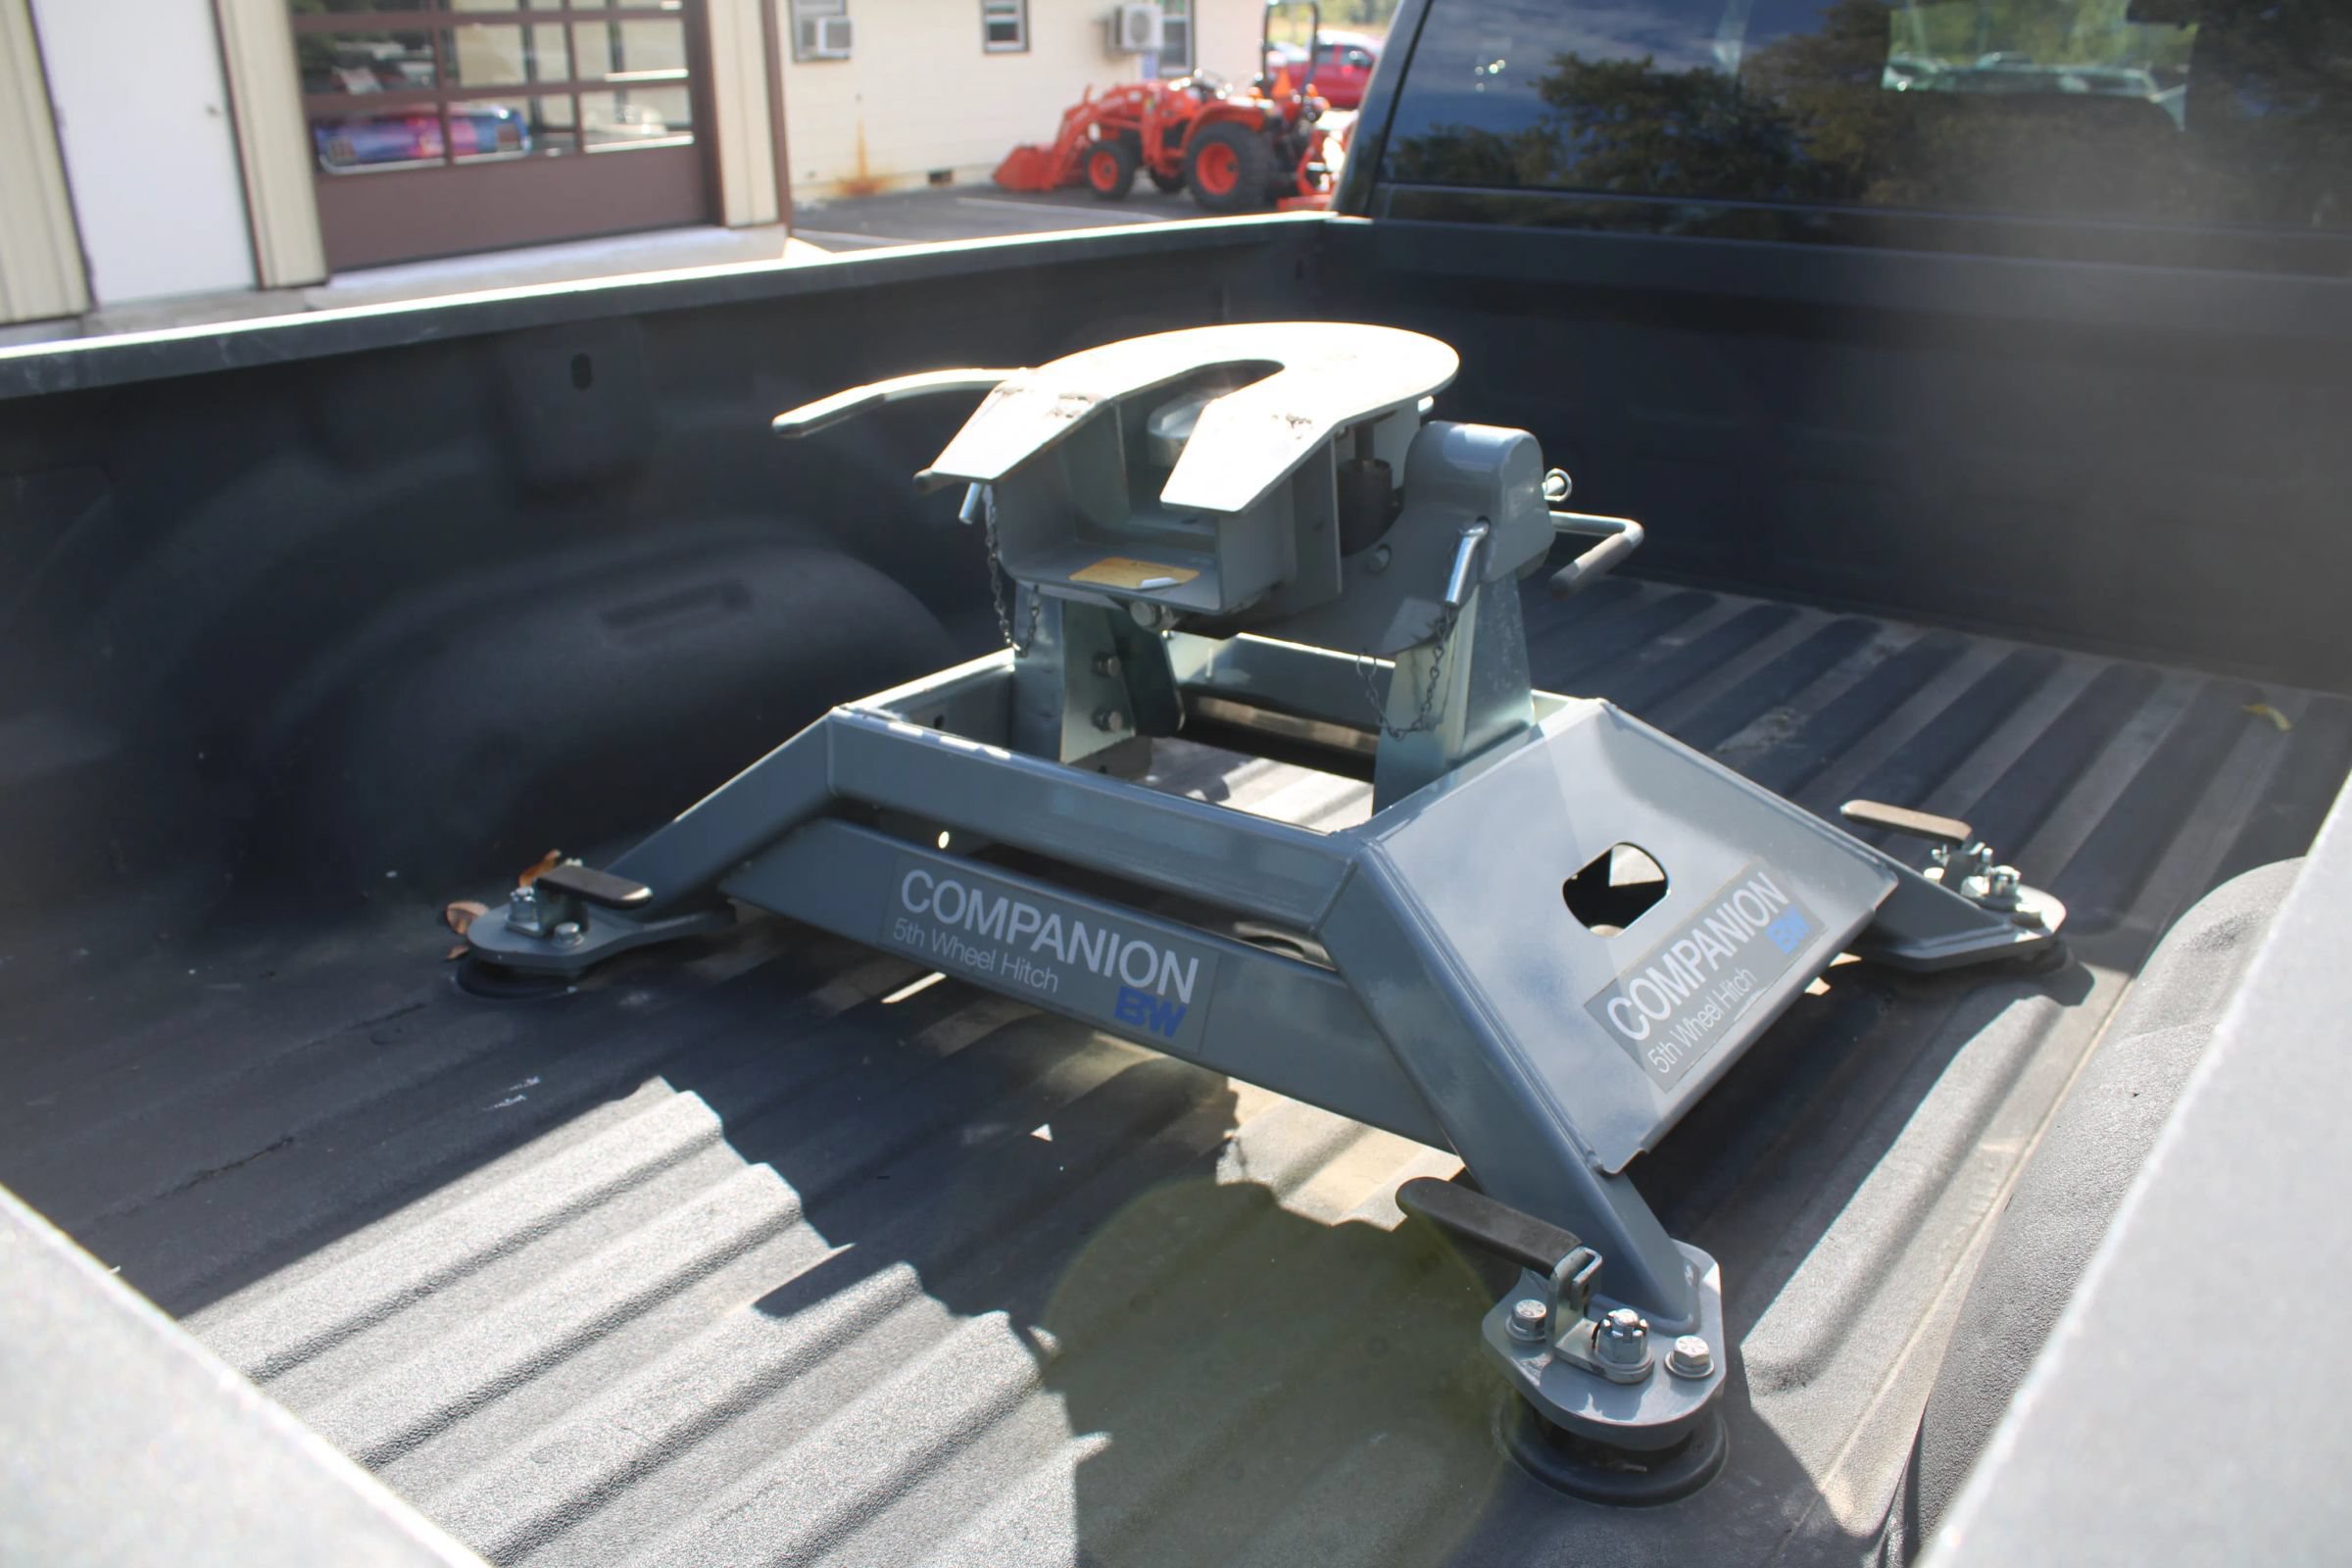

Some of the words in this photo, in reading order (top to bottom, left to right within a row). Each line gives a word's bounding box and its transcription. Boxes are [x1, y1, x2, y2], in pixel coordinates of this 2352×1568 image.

[893, 917, 925, 948] 5th
[932, 927, 996, 972] Wheel
[1001, 953, 1058, 994] Hitch
[902, 869, 1200, 1004] COMPANION
[1607, 871, 1789, 1040] COMPANION
[1647, 1039, 1683, 1073] 5th
[1670, 996, 1721, 1051] Wheel
[1717, 966, 1757, 1010] Hitch
